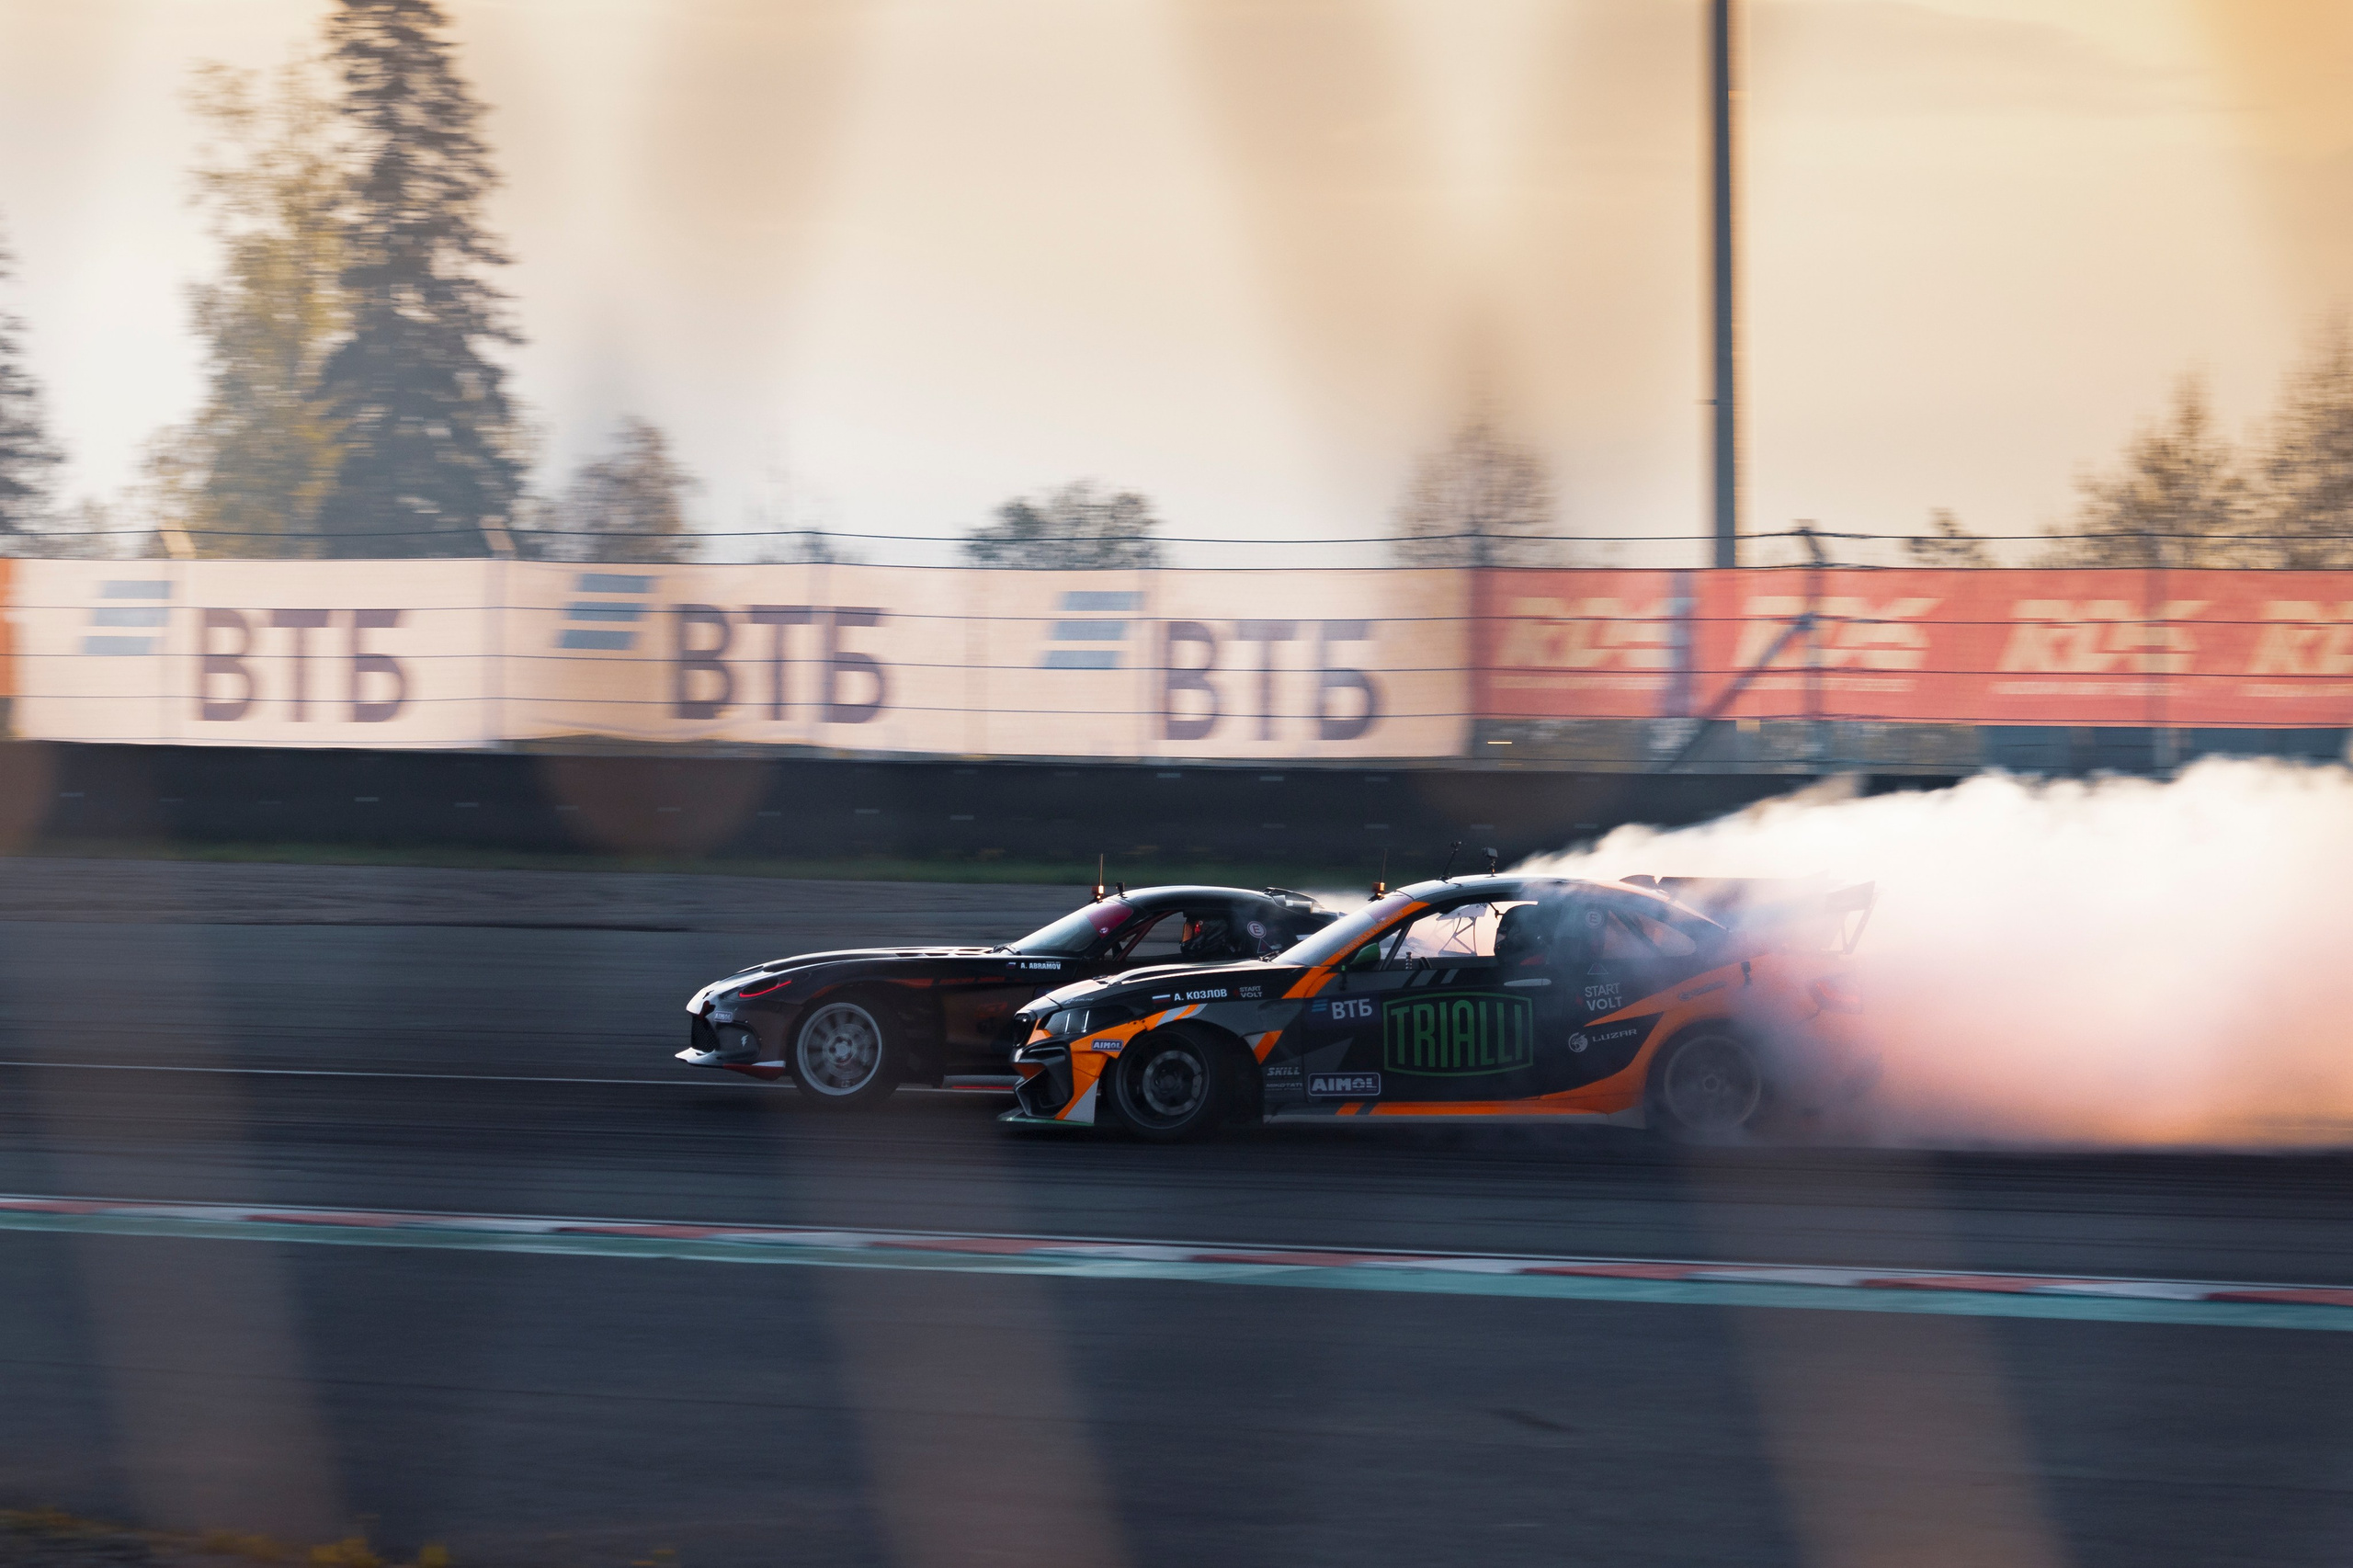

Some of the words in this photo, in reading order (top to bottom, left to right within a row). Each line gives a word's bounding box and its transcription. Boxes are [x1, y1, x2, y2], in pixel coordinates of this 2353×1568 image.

[196, 608, 412, 722] ВТБ
[672, 603, 887, 723] ВТБ
[1160, 619, 1384, 741] ВТБ
[1186, 988, 1228, 1001] КОЗЛОВ
[1584, 983, 1620, 998] START
[1331, 998, 1372, 1020] ВТБ
[1586, 995, 1622, 1011] VOLT
[1391, 999, 1523, 1068] TRIALLI
[1592, 1028, 1637, 1042] LUZAR
[1311, 1077, 1378, 1092] AIMOL
